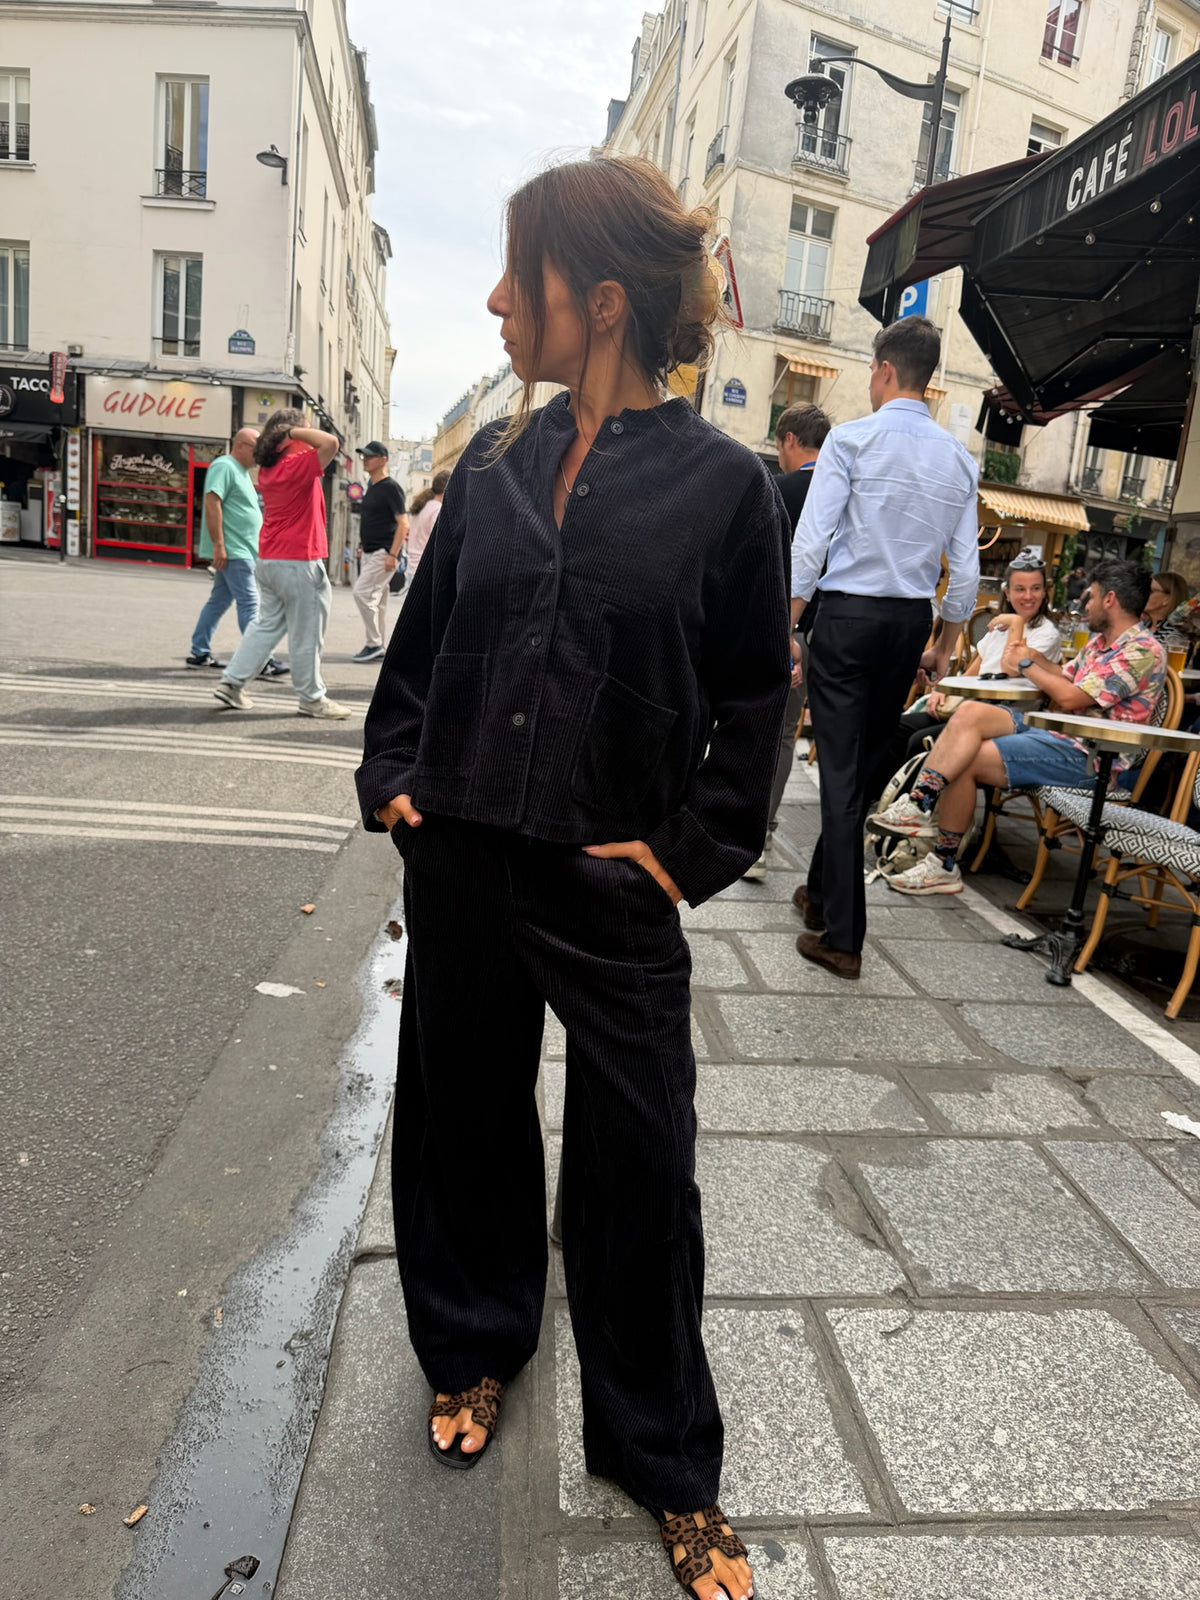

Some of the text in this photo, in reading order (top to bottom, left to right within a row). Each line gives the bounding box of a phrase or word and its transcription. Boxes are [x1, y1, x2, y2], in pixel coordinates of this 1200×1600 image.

[1066, 90, 1199, 212] CAFÉ LOL
[899, 286, 918, 317] P
[103, 390, 207, 419] GUDULE
